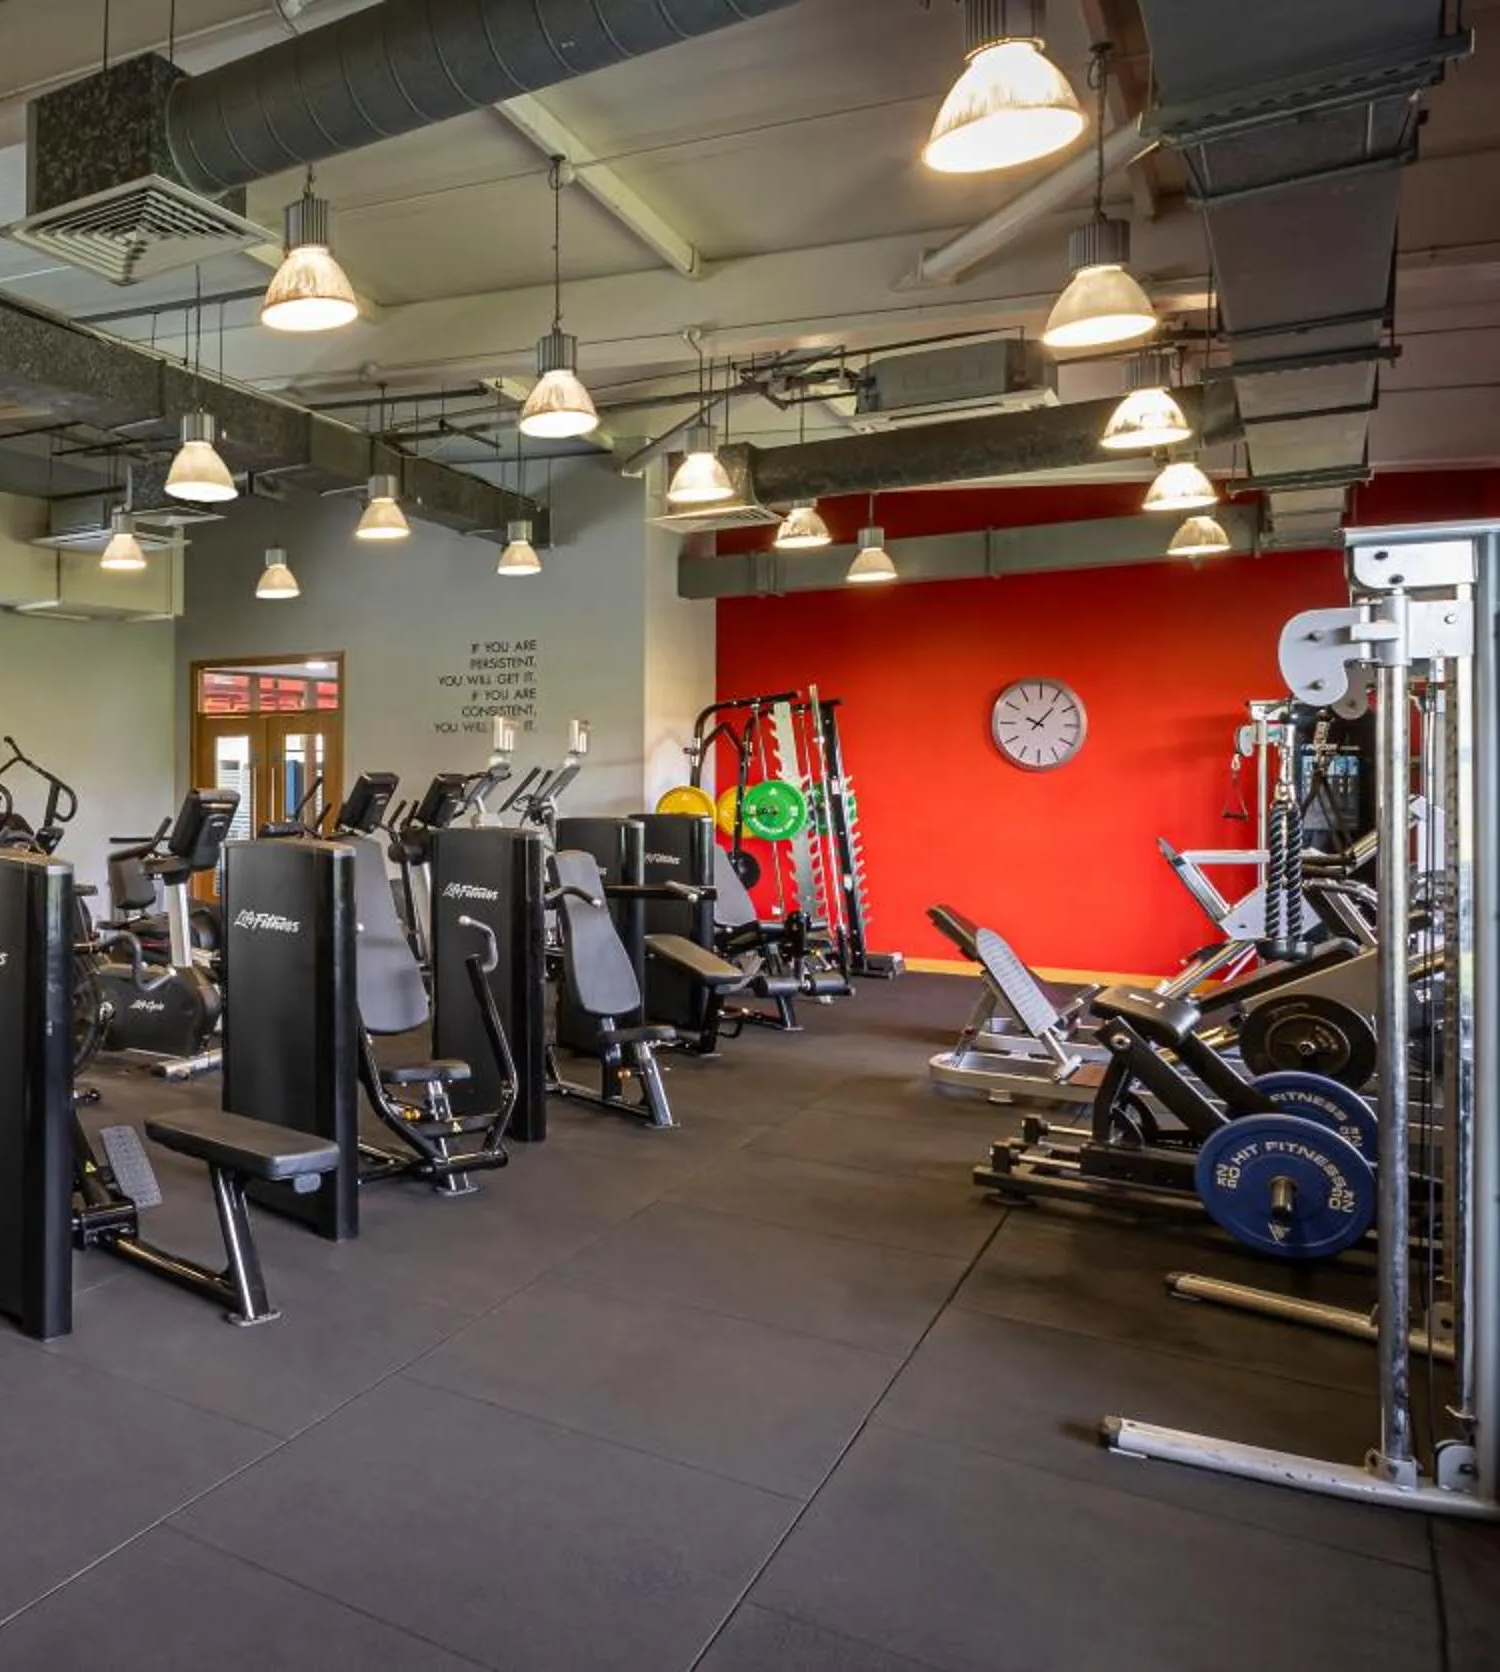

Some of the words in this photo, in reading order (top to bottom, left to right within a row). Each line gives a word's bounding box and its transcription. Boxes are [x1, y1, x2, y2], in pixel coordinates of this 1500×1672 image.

[485, 641, 509, 653] YOU
[514, 639, 537, 651] ARE
[438, 675, 463, 687] YOU
[467, 674, 491, 685] WILL
[497, 672, 519, 685] GET
[485, 689, 509, 701] YOU
[514, 688, 537, 700] ARE
[434, 722, 459, 733] YOU
[462, 722, 487, 733] WILL
[1231, 1142, 1259, 1165] HIT
[1264, 1141, 1348, 1189] FITNESS
